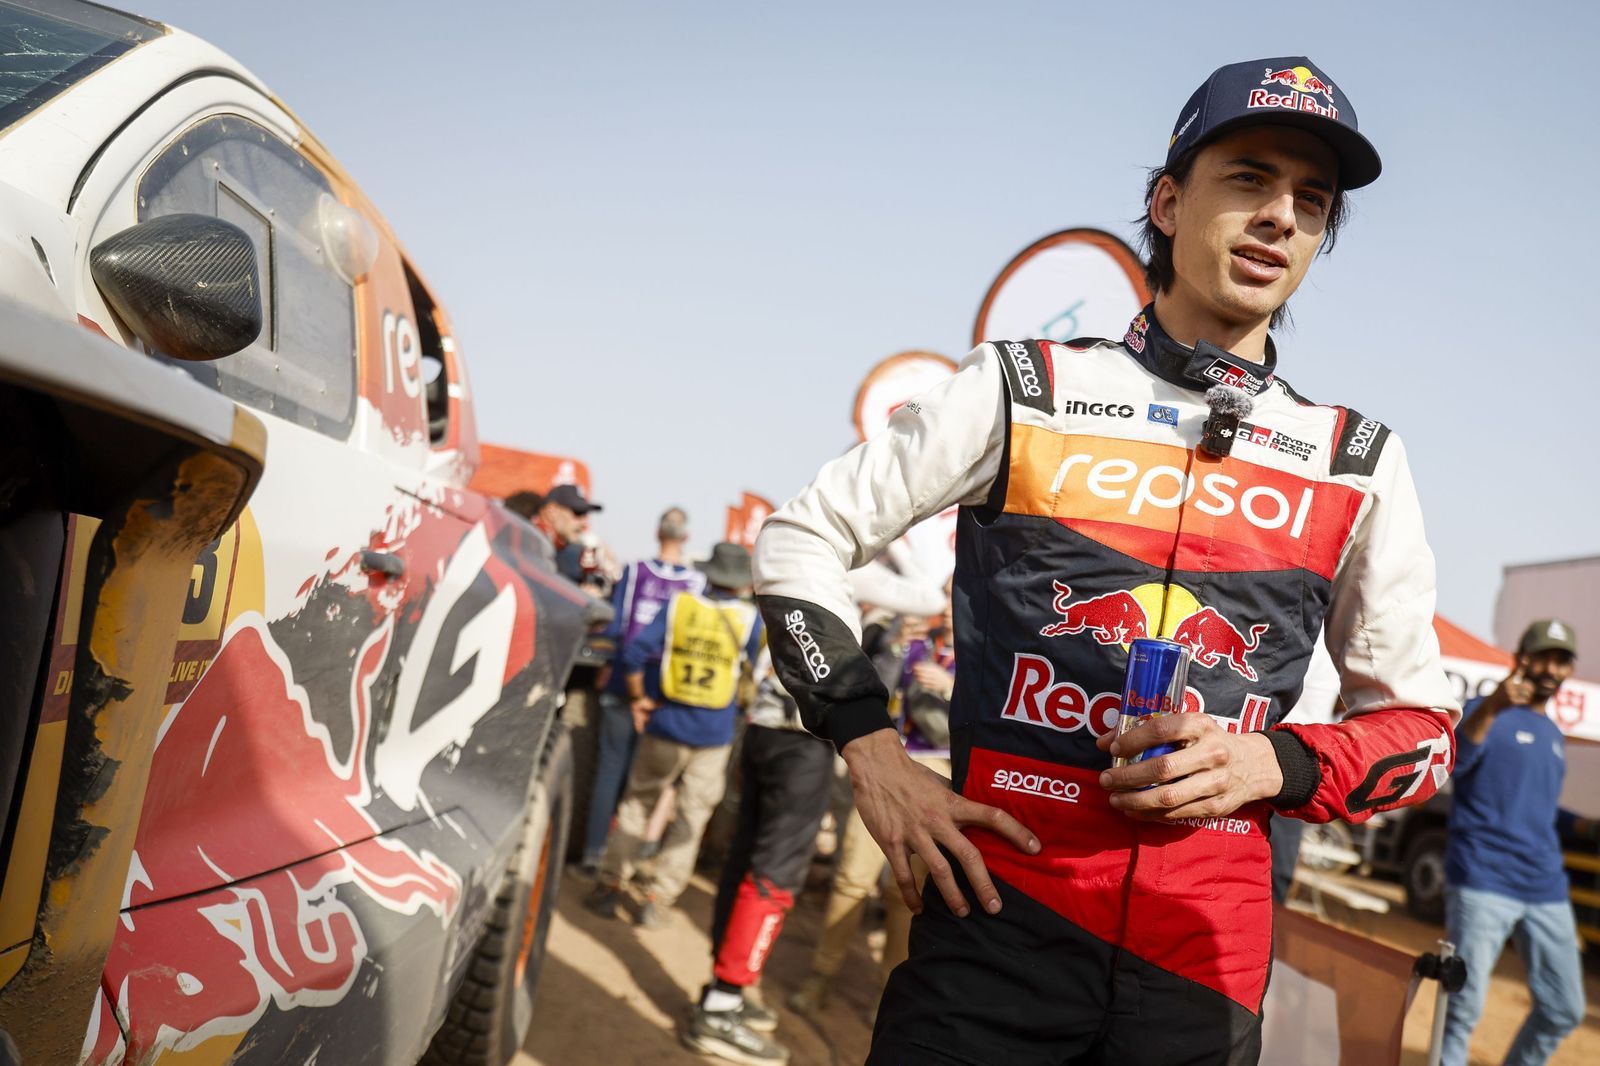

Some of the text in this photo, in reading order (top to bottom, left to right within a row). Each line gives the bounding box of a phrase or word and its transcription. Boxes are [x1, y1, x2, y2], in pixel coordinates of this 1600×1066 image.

[1248, 89, 1298, 109] Red
[1004, 342, 1042, 398] sparco
[1208, 365, 1240, 386] GR
[1235, 425, 1270, 446] GR
[1275, 431, 1318, 451] TOYOTA
[1268, 442, 1309, 462] Racing
[1271, 438, 1312, 455] GAZOO
[1048, 453, 1314, 539] repsol
[784, 609, 831, 683] sparco
[682, 664, 716, 689] 12
[1127, 690, 1158, 711] Red
[991, 767, 1081, 804] sparco
